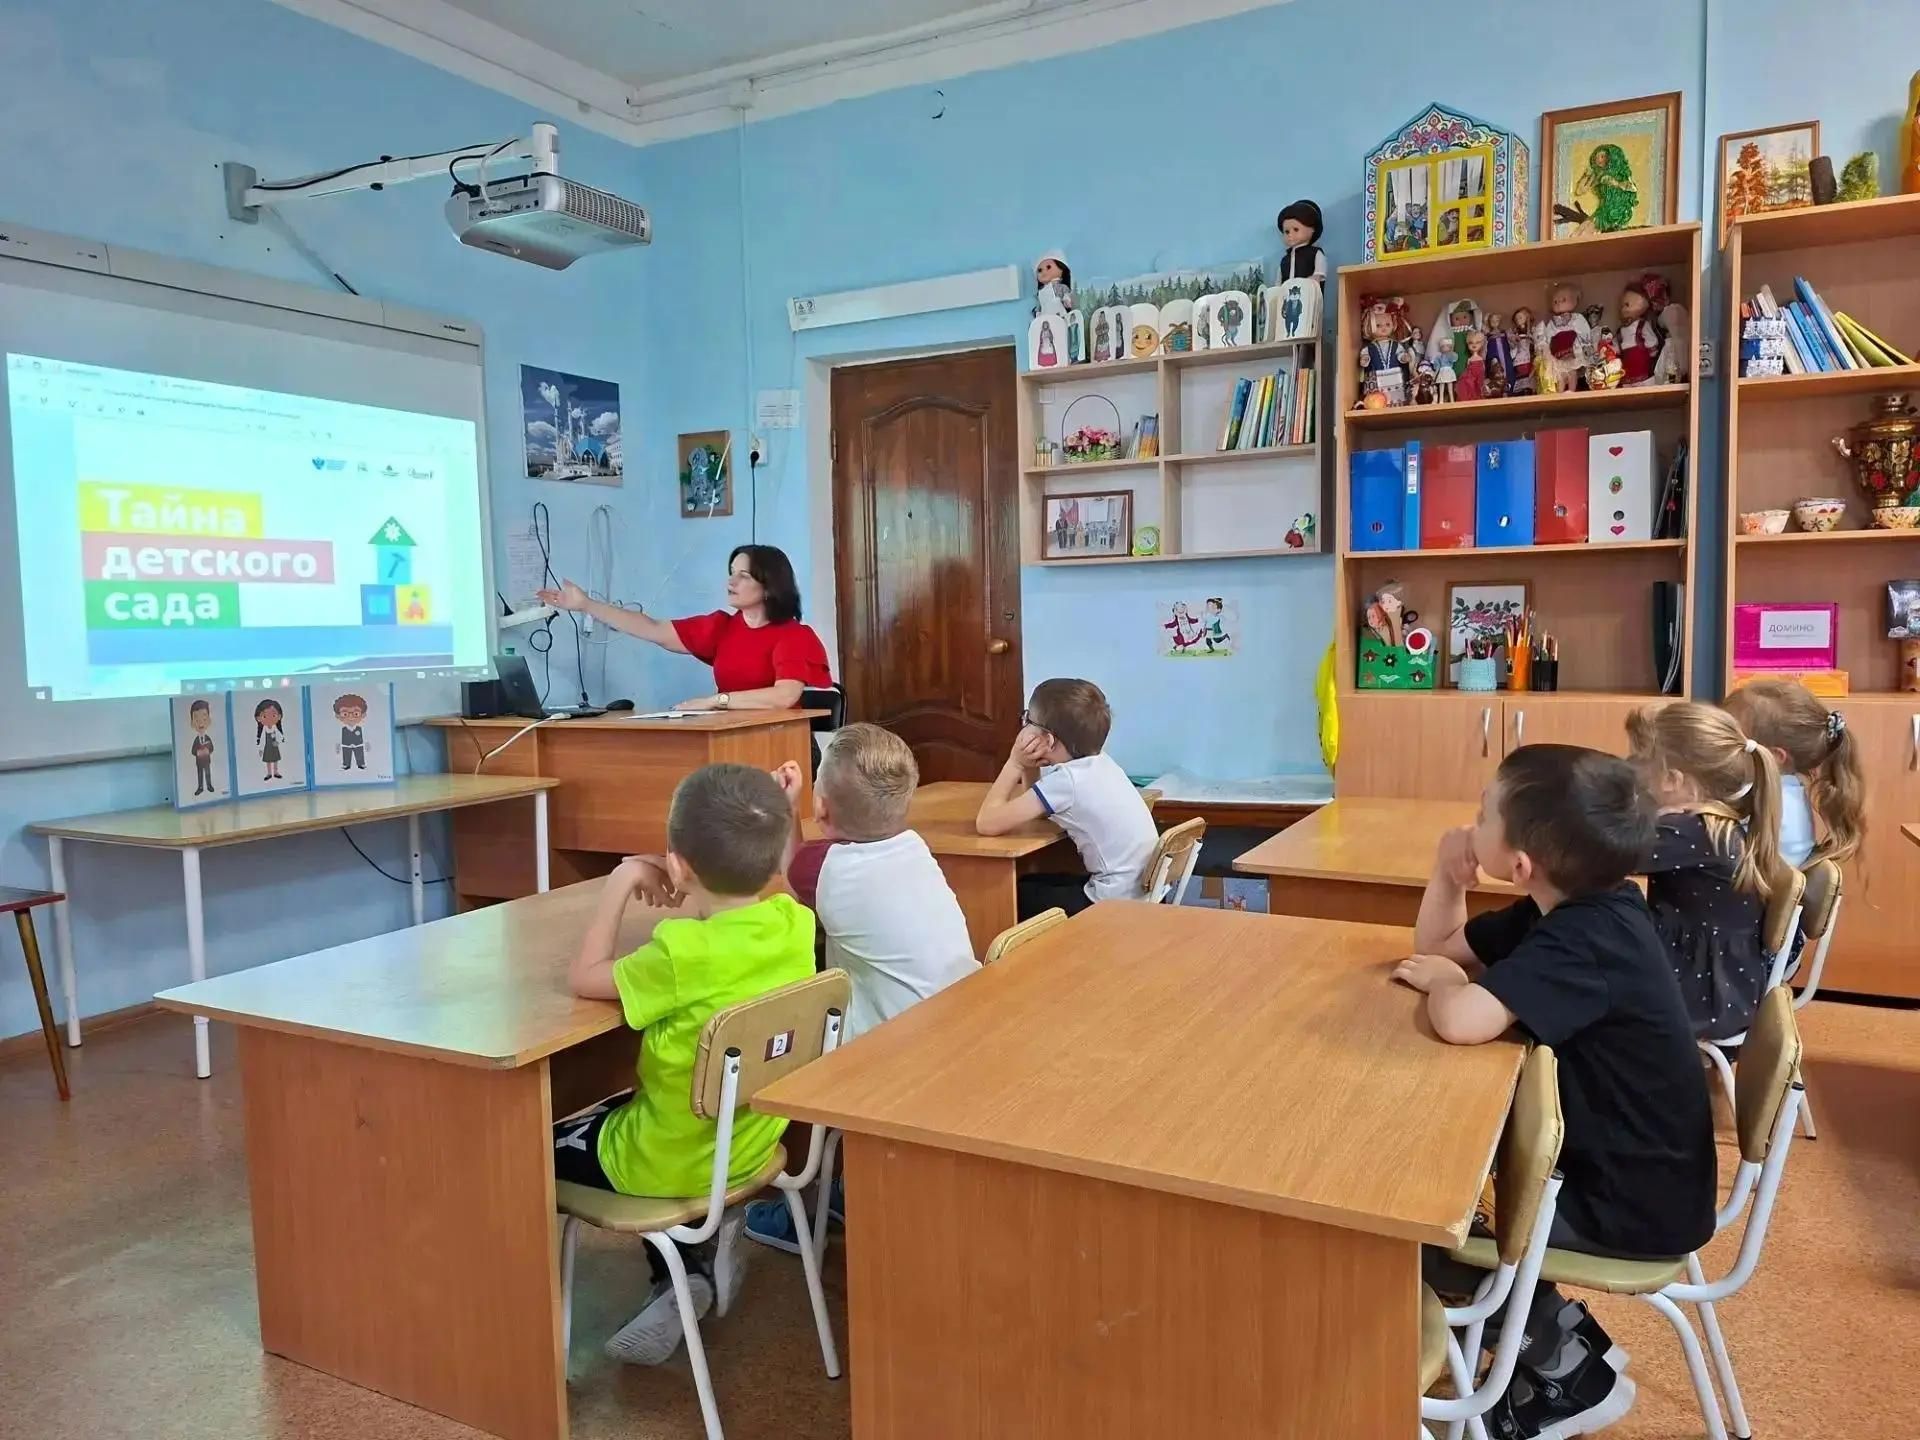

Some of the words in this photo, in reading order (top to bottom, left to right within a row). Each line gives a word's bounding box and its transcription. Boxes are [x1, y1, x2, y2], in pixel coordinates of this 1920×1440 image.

[97, 489, 247, 536] Тайна
[102, 547, 317, 580] детского
[104, 592, 220, 626] сада
[1769, 624, 1814, 632] ДОМИНО
[776, 1038, 784, 1052] 2
